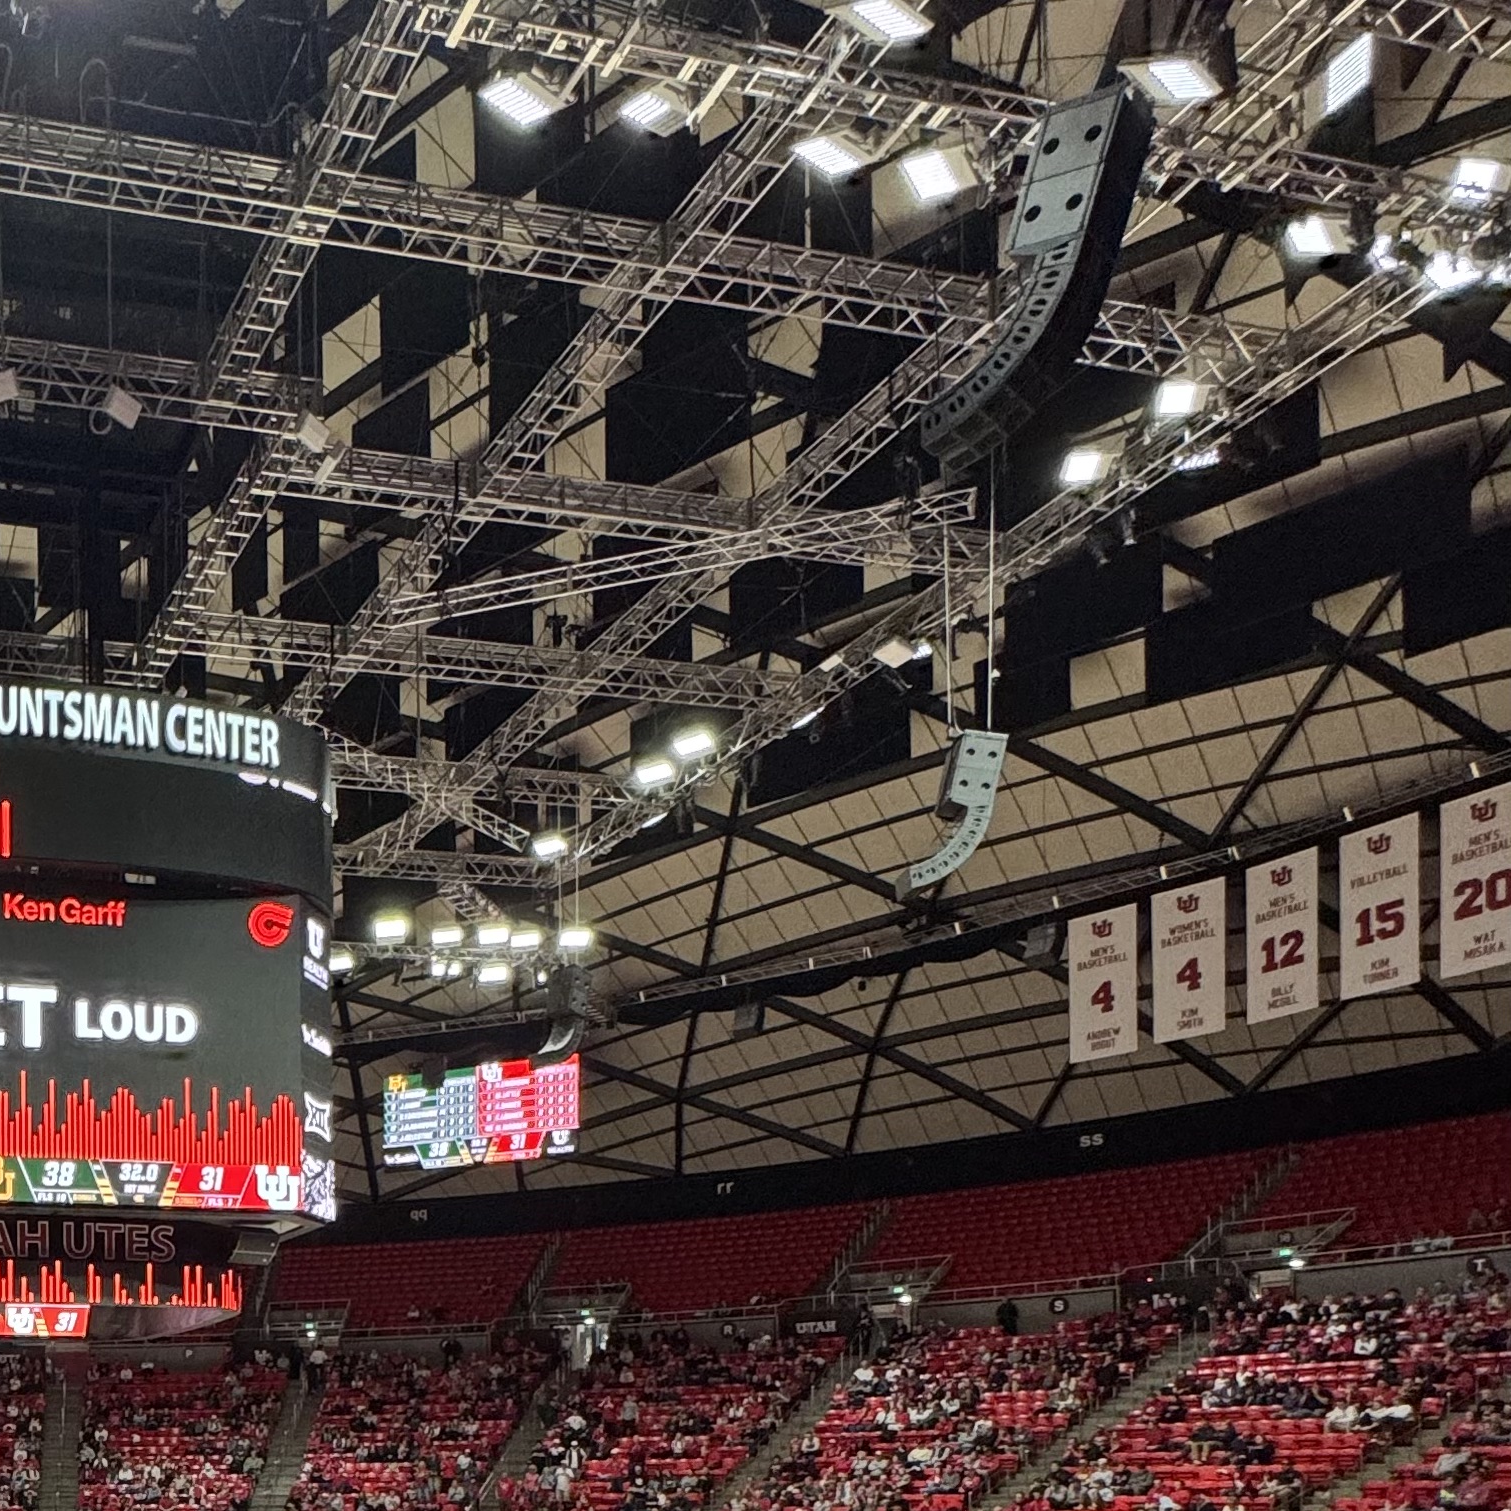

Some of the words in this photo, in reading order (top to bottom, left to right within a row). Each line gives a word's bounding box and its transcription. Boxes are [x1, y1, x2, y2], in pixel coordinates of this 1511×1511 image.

[165, 703, 281, 768] CENTER
[1350, 863, 1408, 889] VOLLEYBALL
[1454, 868, 1511, 921] 20
[3, 893, 54, 922] Ken
[59, 897, 126, 927] Garff
[1255, 900, 1308, 924] BASKETBALL
[1355, 898, 1405, 947] 15
[1161, 928, 1217, 949] BASKETBALL
[1261, 929, 1304, 974] 12
[1176, 957, 1202, 991] 4
[1091, 980, 1115, 1013] 4
[74, 998, 199, 1043] LOUD
[42, 1161, 77, 1186] 38
[119, 1163, 159, 1182] 32.0
[199, 1166, 224, 1191] 31
[410, 1209, 427, 1220] qq
[63, 1222, 176, 1262] UTES
[1473, 1259, 1486, 1271] T
[1054, 1301, 1064, 1311] S
[54, 1312, 78, 1332] 31
[724, 1325, 733, 1334] R
[796, 1321, 836, 1334] UTAH
